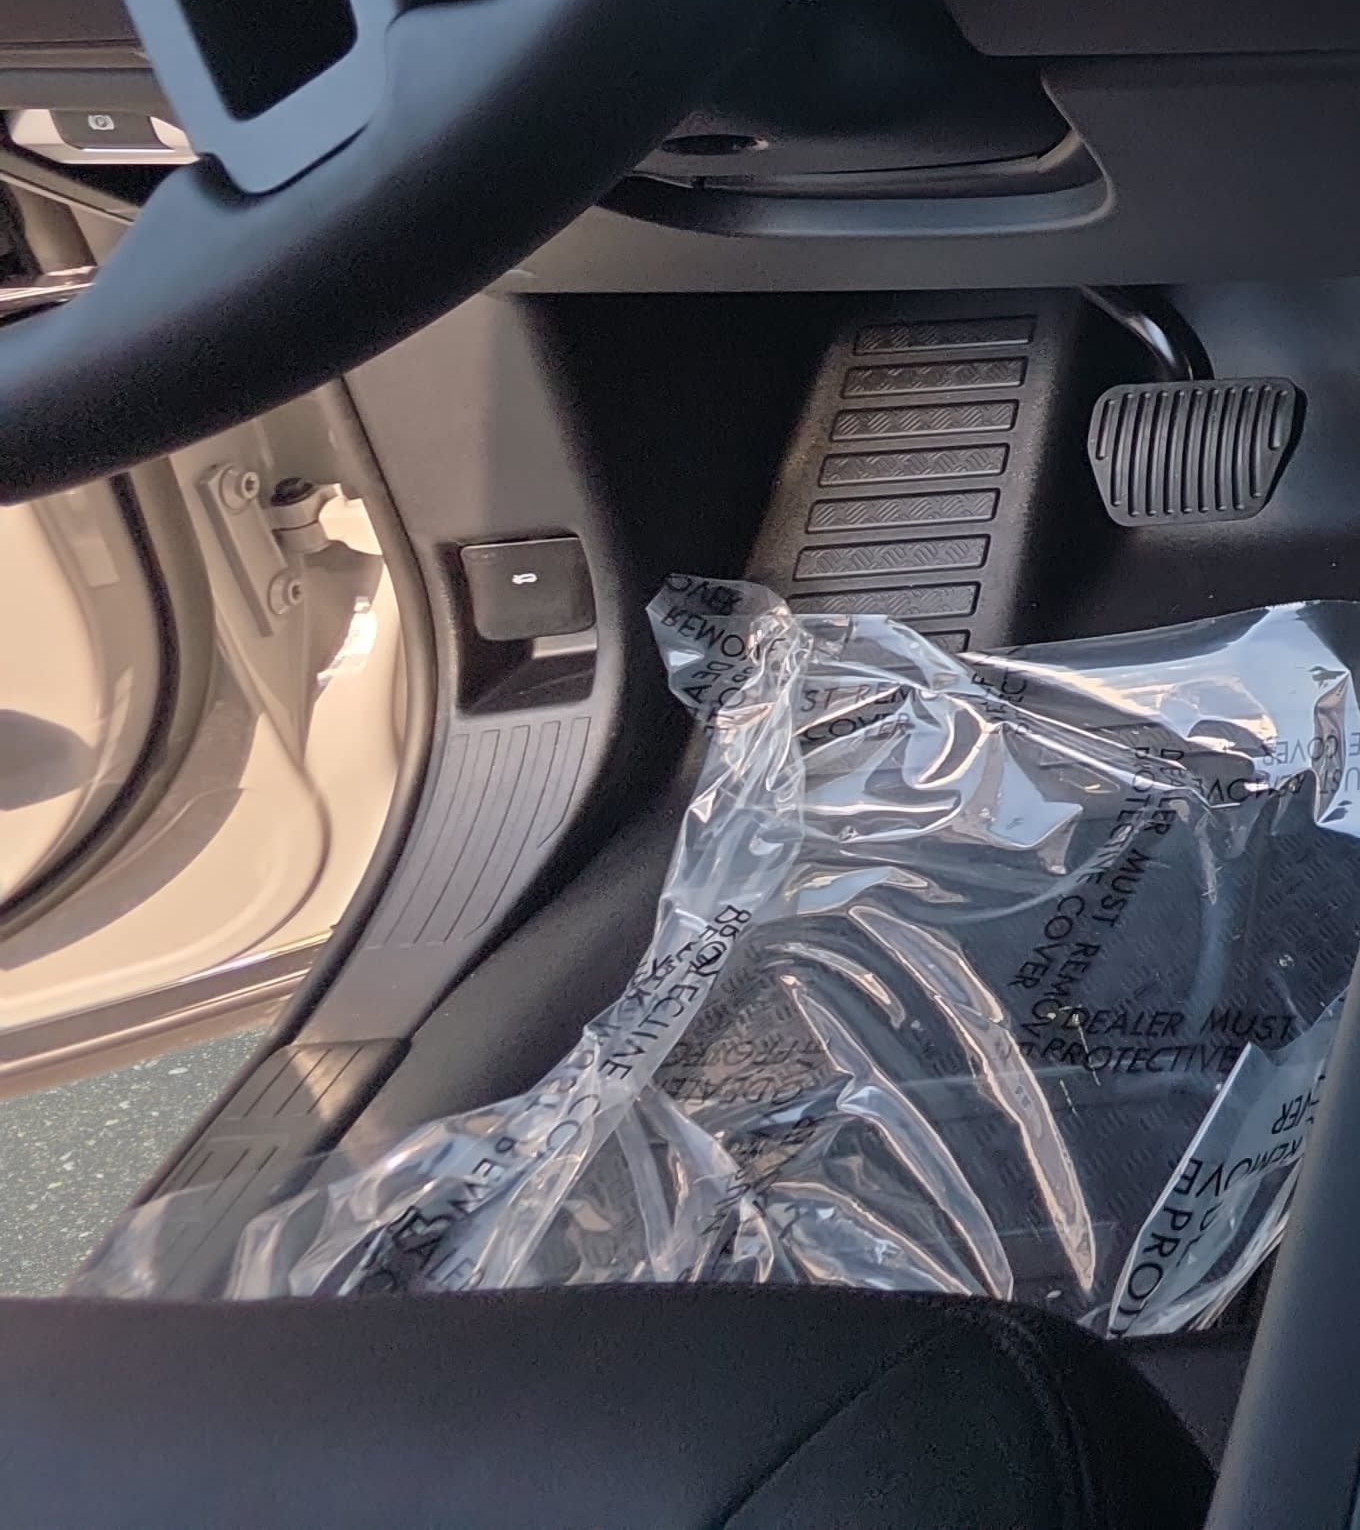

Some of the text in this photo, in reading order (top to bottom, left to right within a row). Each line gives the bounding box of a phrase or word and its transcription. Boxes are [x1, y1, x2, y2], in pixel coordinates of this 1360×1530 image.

[1092, 848, 1153, 928] MUST
[1009, 894, 1086, 991] COVER
[1063, 1007, 1299, 1042] DEALER MUST
